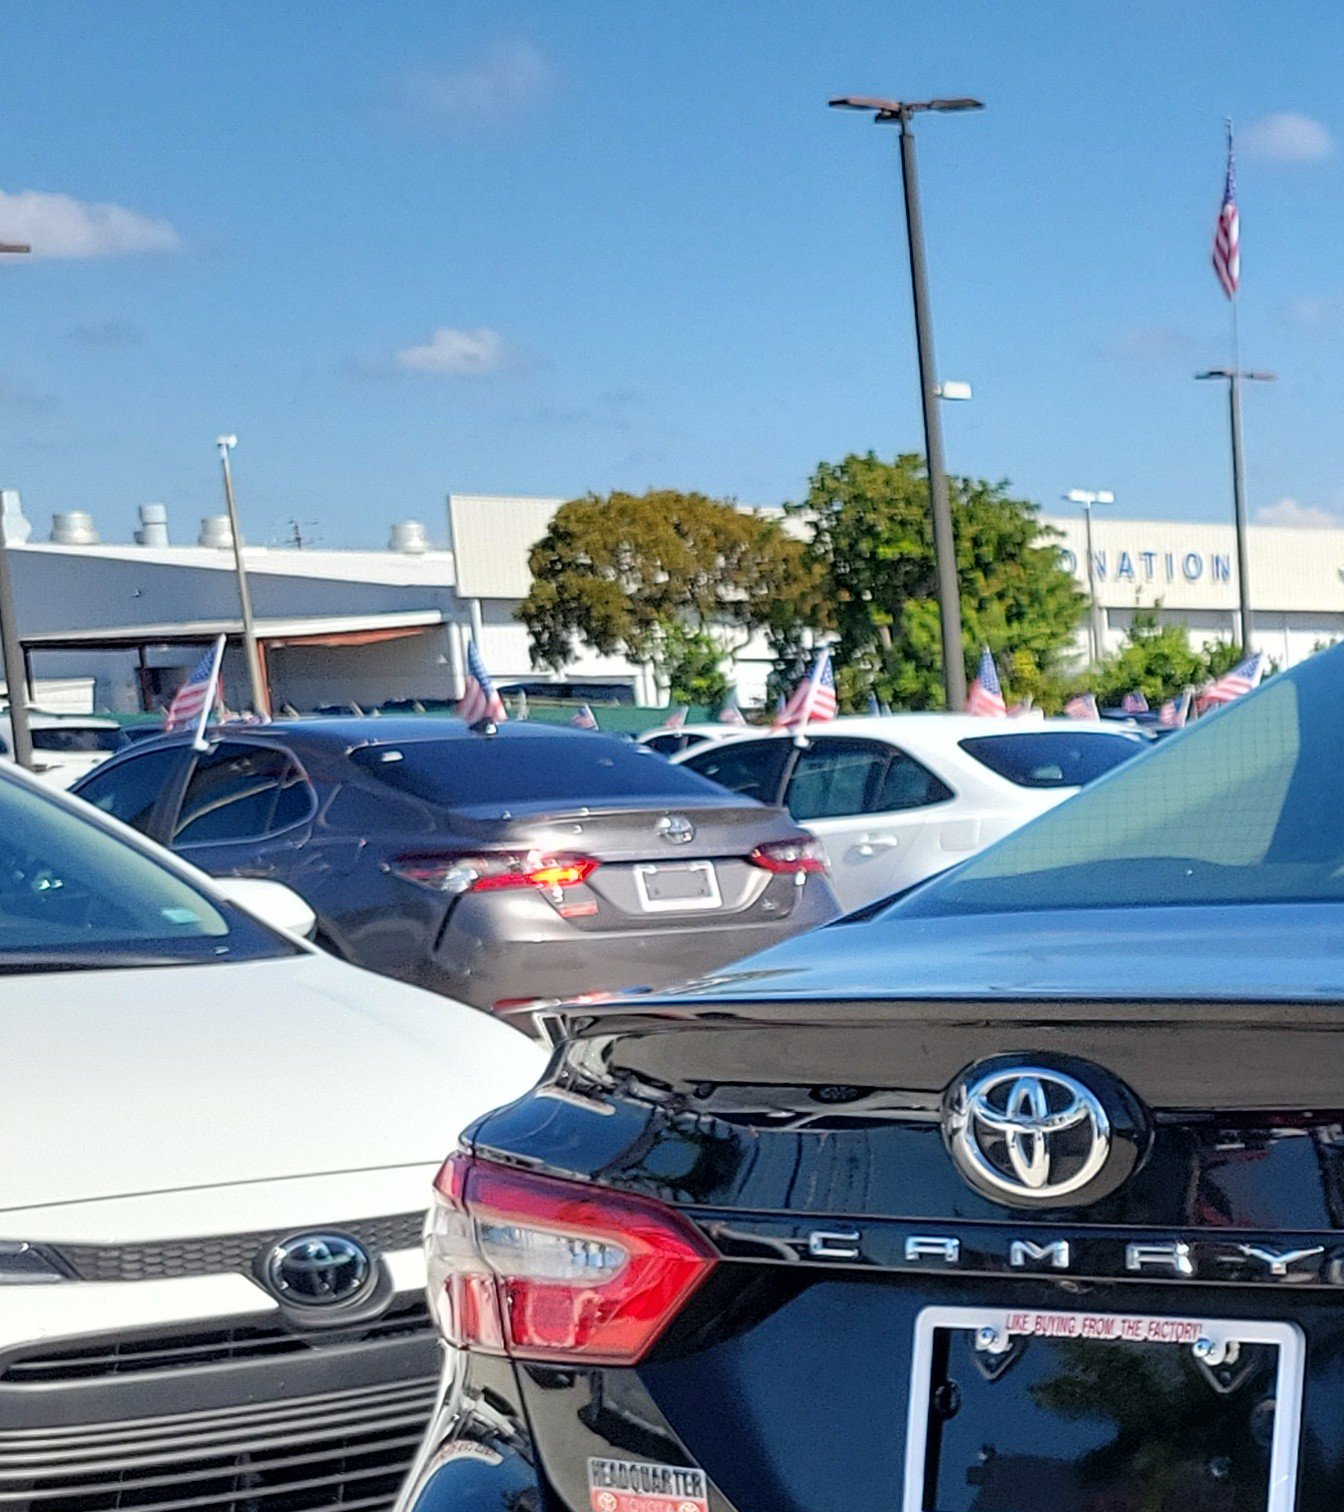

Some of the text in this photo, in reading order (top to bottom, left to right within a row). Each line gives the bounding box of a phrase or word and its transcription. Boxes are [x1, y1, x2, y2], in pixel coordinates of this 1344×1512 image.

[808, 1230, 1325, 1275] CAMRY
[1006, 1313, 1029, 1331] LIKE
[1034, 1315, 1076, 1334] BUYING
[1082, 1317, 1115, 1336] FROM
[1121, 1319, 1142, 1338] THE
[592, 1460, 705, 1499] HEADQUARTER
